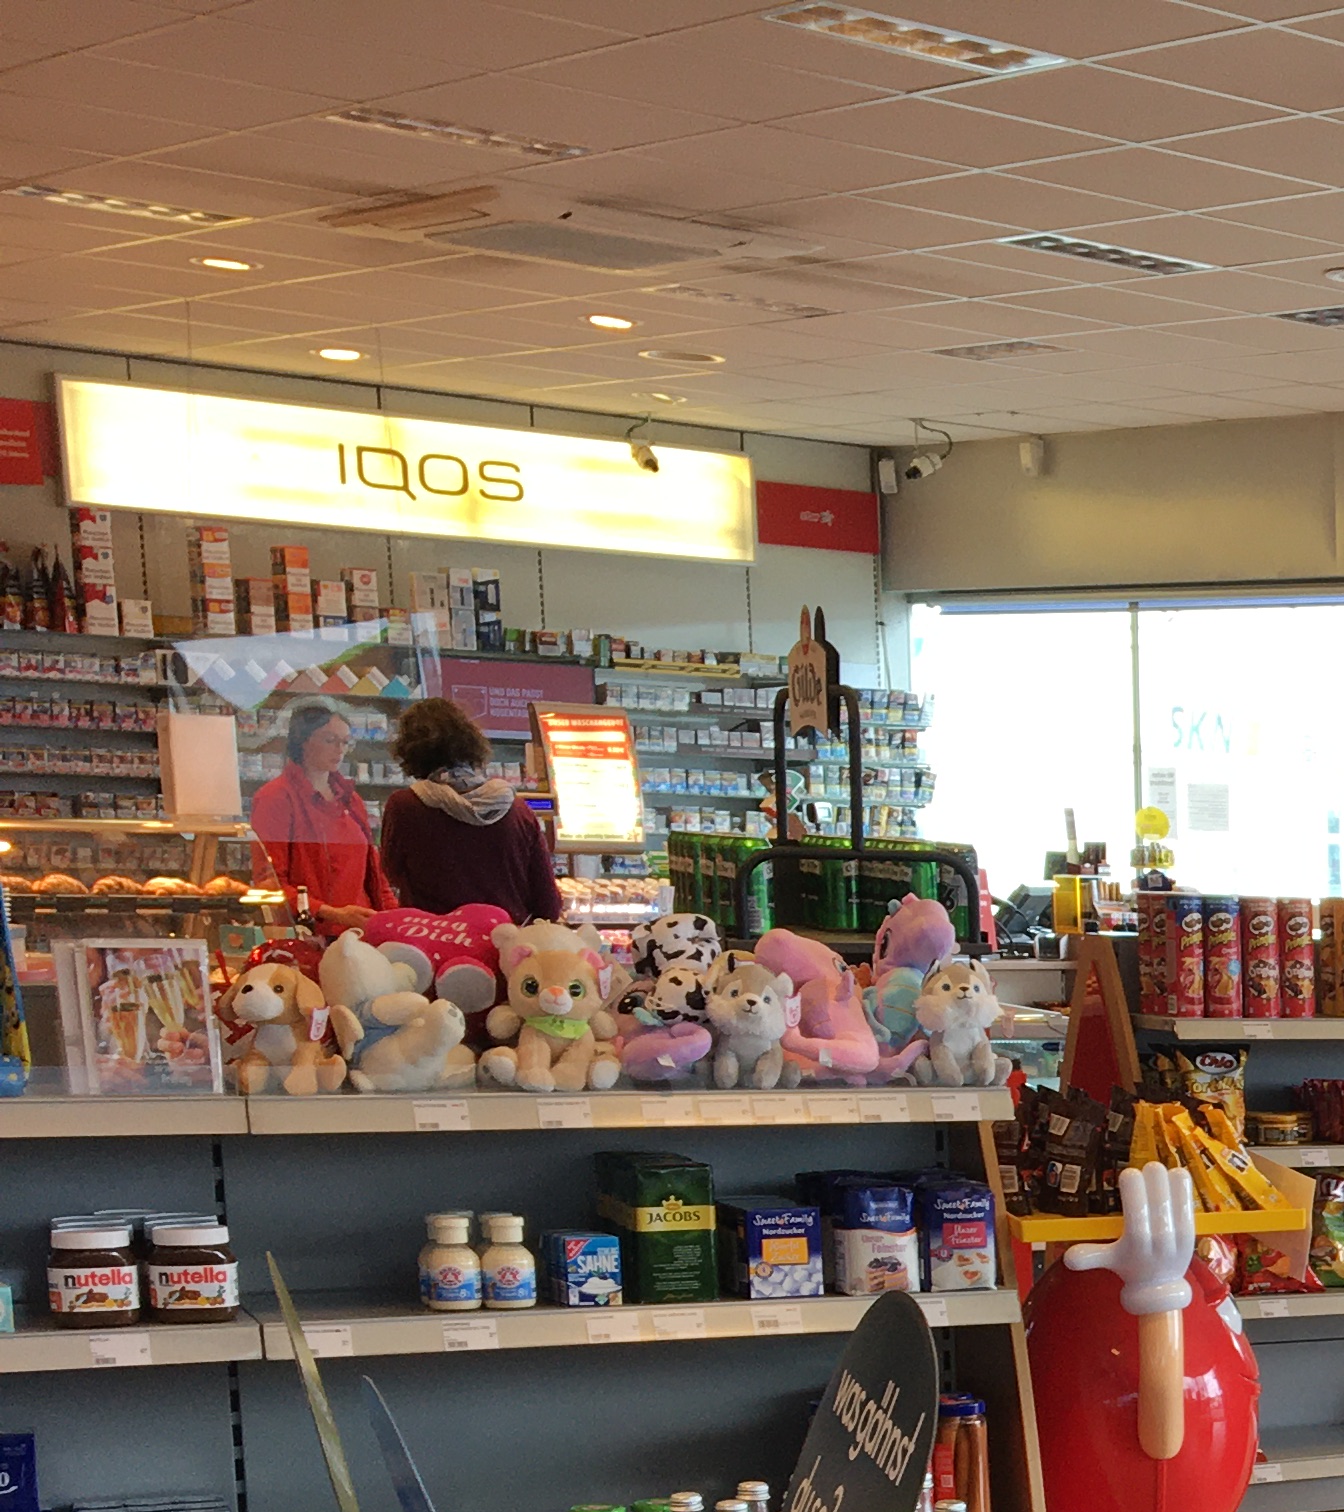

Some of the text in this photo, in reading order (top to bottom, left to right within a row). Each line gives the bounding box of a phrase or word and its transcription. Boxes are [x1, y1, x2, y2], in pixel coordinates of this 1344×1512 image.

[337, 443, 525, 503] IQOS
[401, 914, 450, 933] mag
[404, 923, 474, 949] Dich
[647, 1211, 701, 1225] JACOBS
[762, 1227, 806, 1236] Nordzucker
[577, 1254, 619, 1273] SAHNE
[63, 1268, 133, 1288] nutella
[158, 1266, 227, 1287] nutella
[848, 1380, 925, 1486] gähnst
